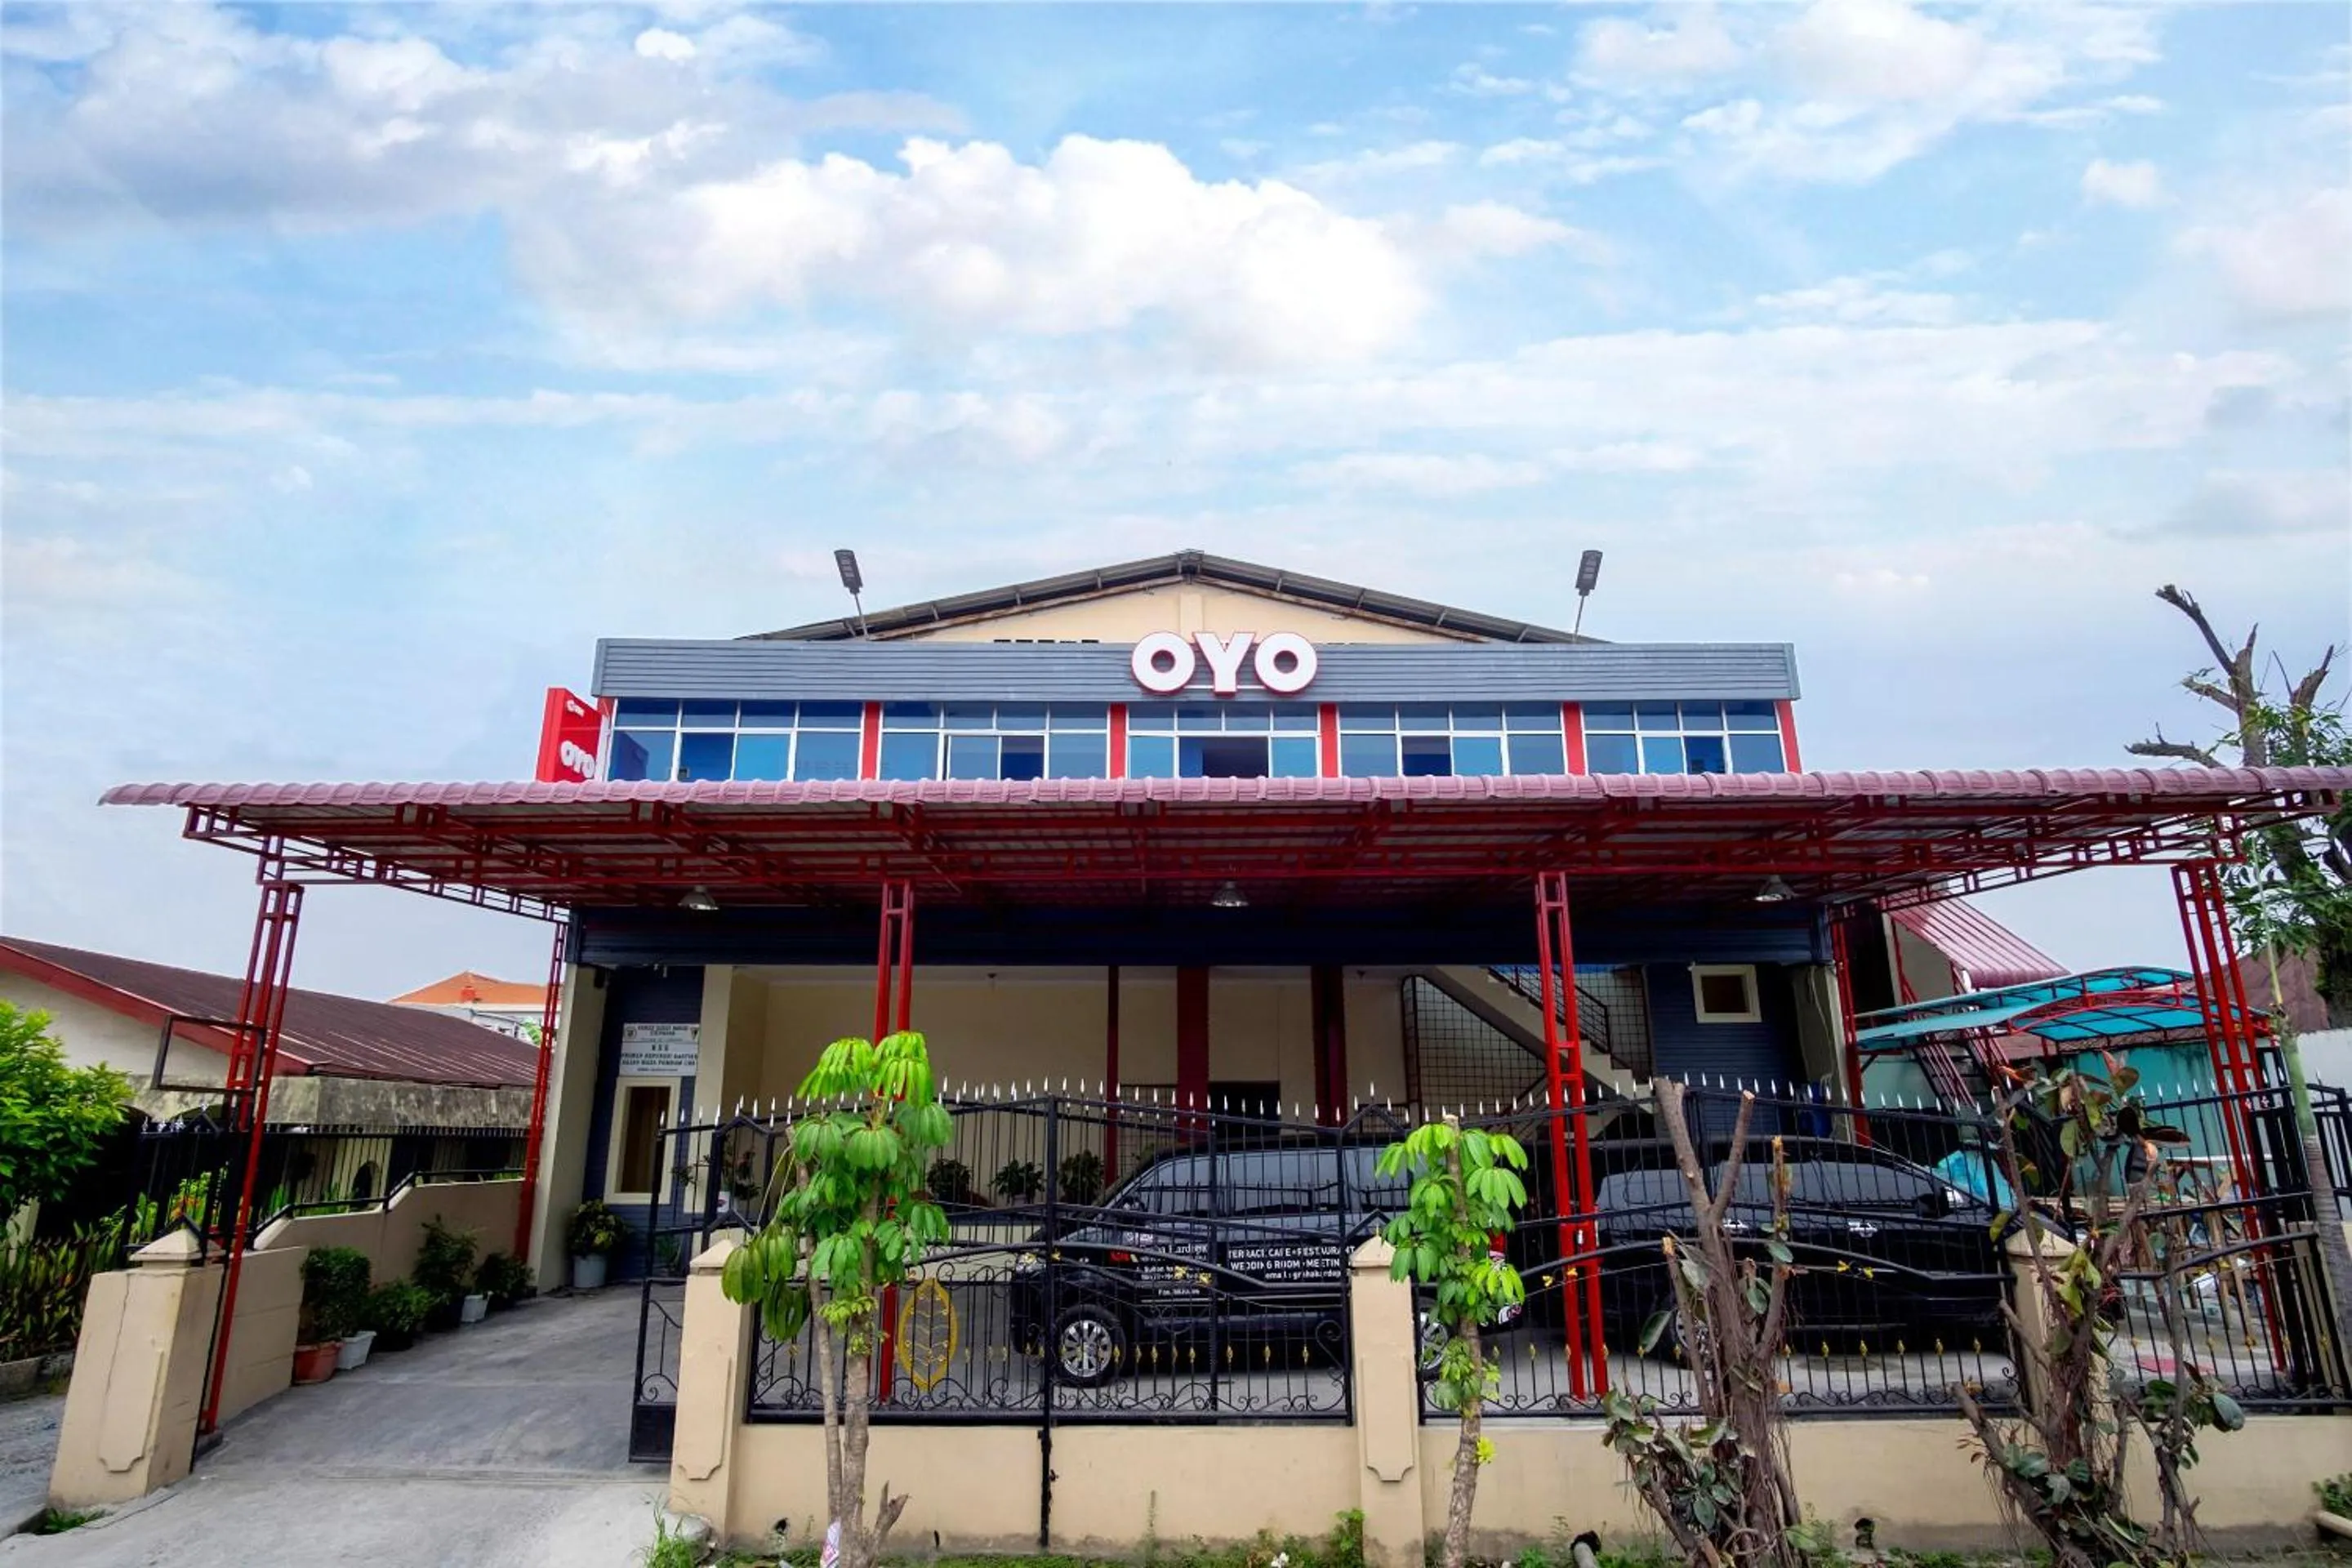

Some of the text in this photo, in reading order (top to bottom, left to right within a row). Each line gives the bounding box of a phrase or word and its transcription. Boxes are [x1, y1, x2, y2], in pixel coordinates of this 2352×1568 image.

[1131, 631, 1318, 695] OYO
[561, 740, 596, 780] OYO
[1306, 1258, 1351, 1267] MEETIN
